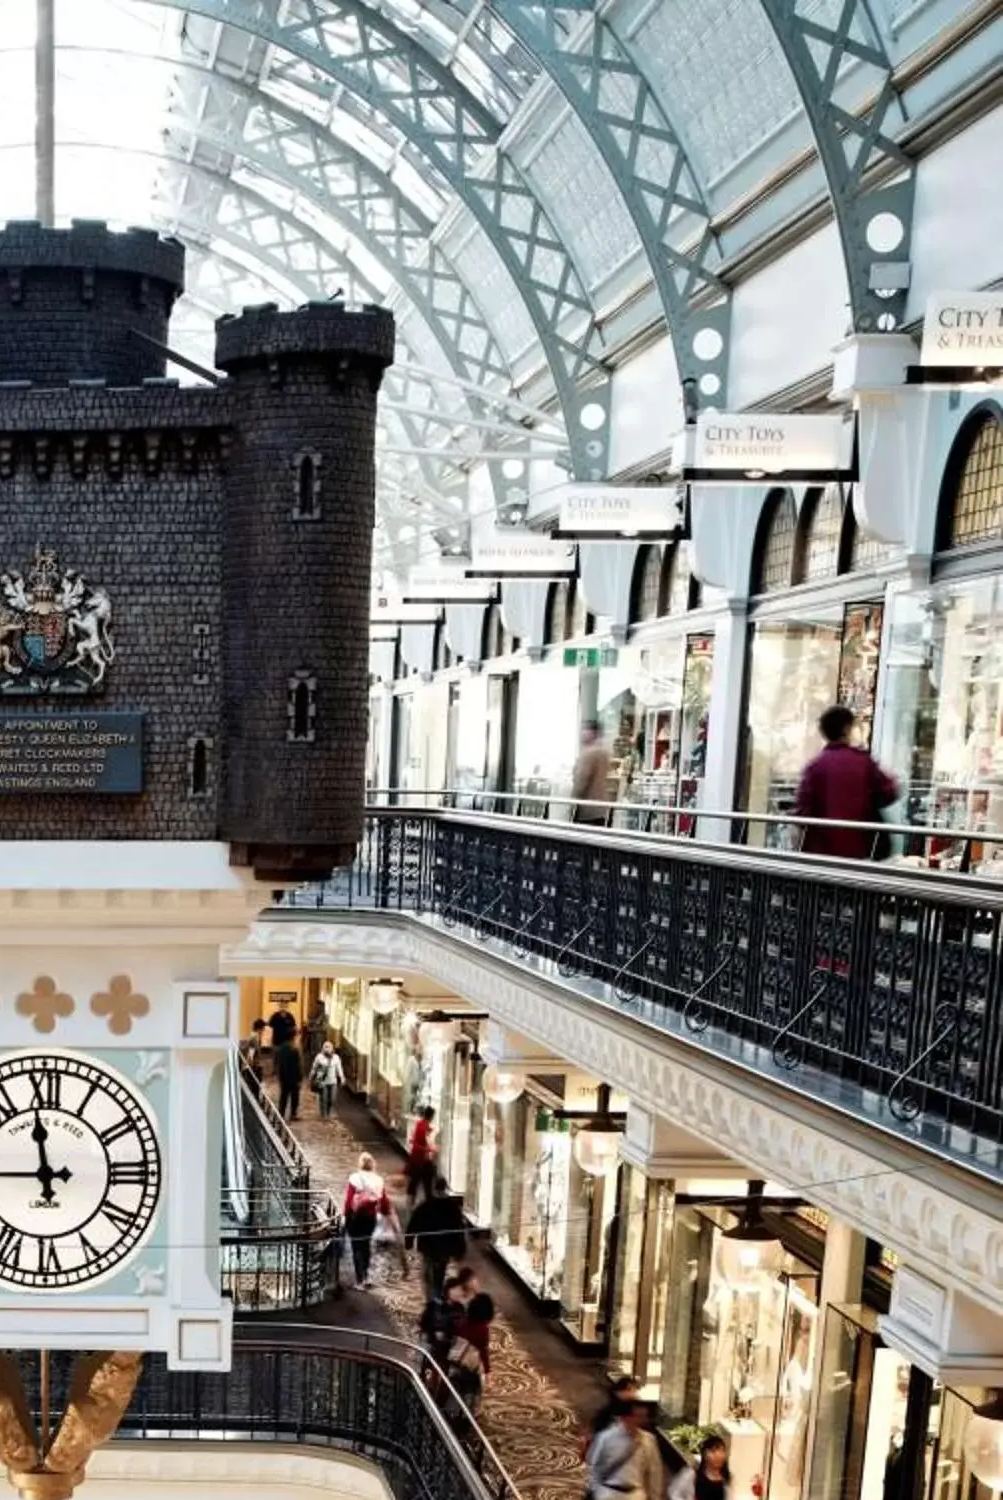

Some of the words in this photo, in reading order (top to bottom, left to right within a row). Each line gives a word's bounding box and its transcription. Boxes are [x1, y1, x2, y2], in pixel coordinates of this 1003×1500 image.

[938, 306, 988, 328] CITY
[705, 426, 741, 441] CITY
[749, 426, 785, 442] TOYS
[5, 720, 78, 731] APPOINTMENT
[83, 720, 98, 731] TO
[29, 733, 66, 745] QUEEN
[69, 733, 127, 745] ELIZABETH
[25, 748, 106, 759] CLOCKMAKERS
[84, 763, 104, 773] LTD
